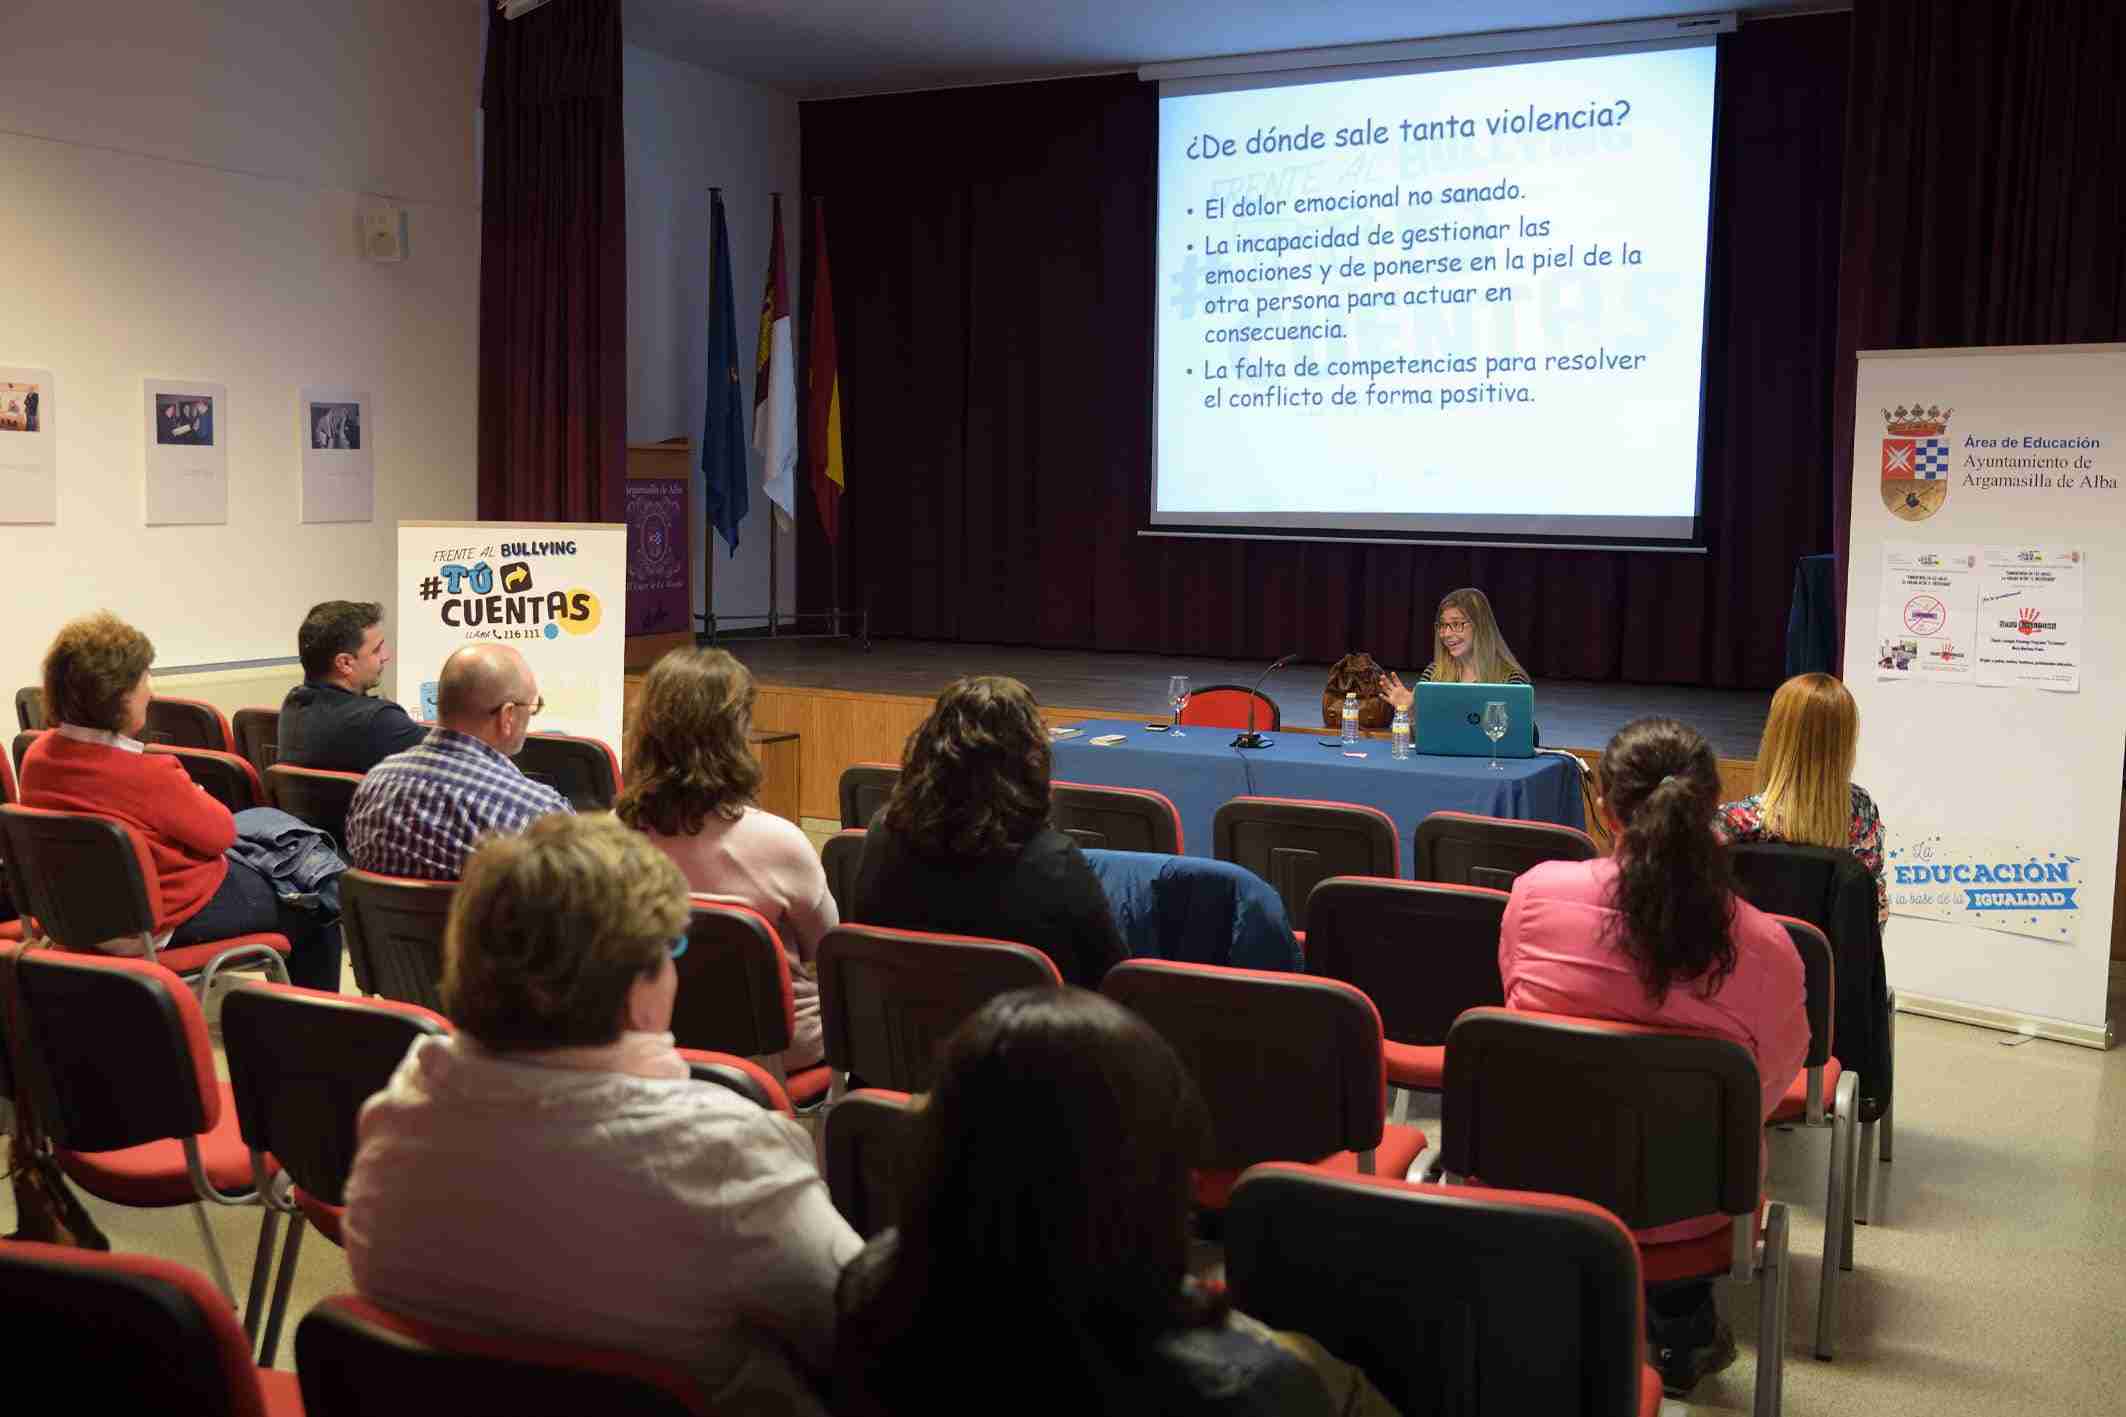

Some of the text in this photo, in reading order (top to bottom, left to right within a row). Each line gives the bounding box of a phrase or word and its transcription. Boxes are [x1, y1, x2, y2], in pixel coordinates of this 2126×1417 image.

[1185, 99, 1632, 161] ¿De dónde sale tanta violencia?
[1205, 177, 1526, 220] El dolor emocional no sanado.
[1205, 215, 1551, 259] La incapacidad de gestionar las
[1204, 241, 1643, 286] emociones y de ponerse en la piel de la
[1204, 284, 1512, 319] otra persona para actuar en
[1204, 323, 1348, 344] consecuencia.
[1204, 346, 1647, 382] La falta de competencias para resolver
[1203, 381, 1536, 411] el conflicto de forma positiva.
[1964, 434, 2100, 448] Área de Educación
[1964, 453, 2092, 472] Ayuntamiento de
[1962, 473, 2118, 489] Argamasilla de Alba
[432, 541, 577, 562] FRENTE AL BULLYING
[440, 591, 590, 627] CUENTAS
[1894, 857, 2071, 885] EDUCACIÓN
[1973, 892, 2066, 906] IGUALDAD
